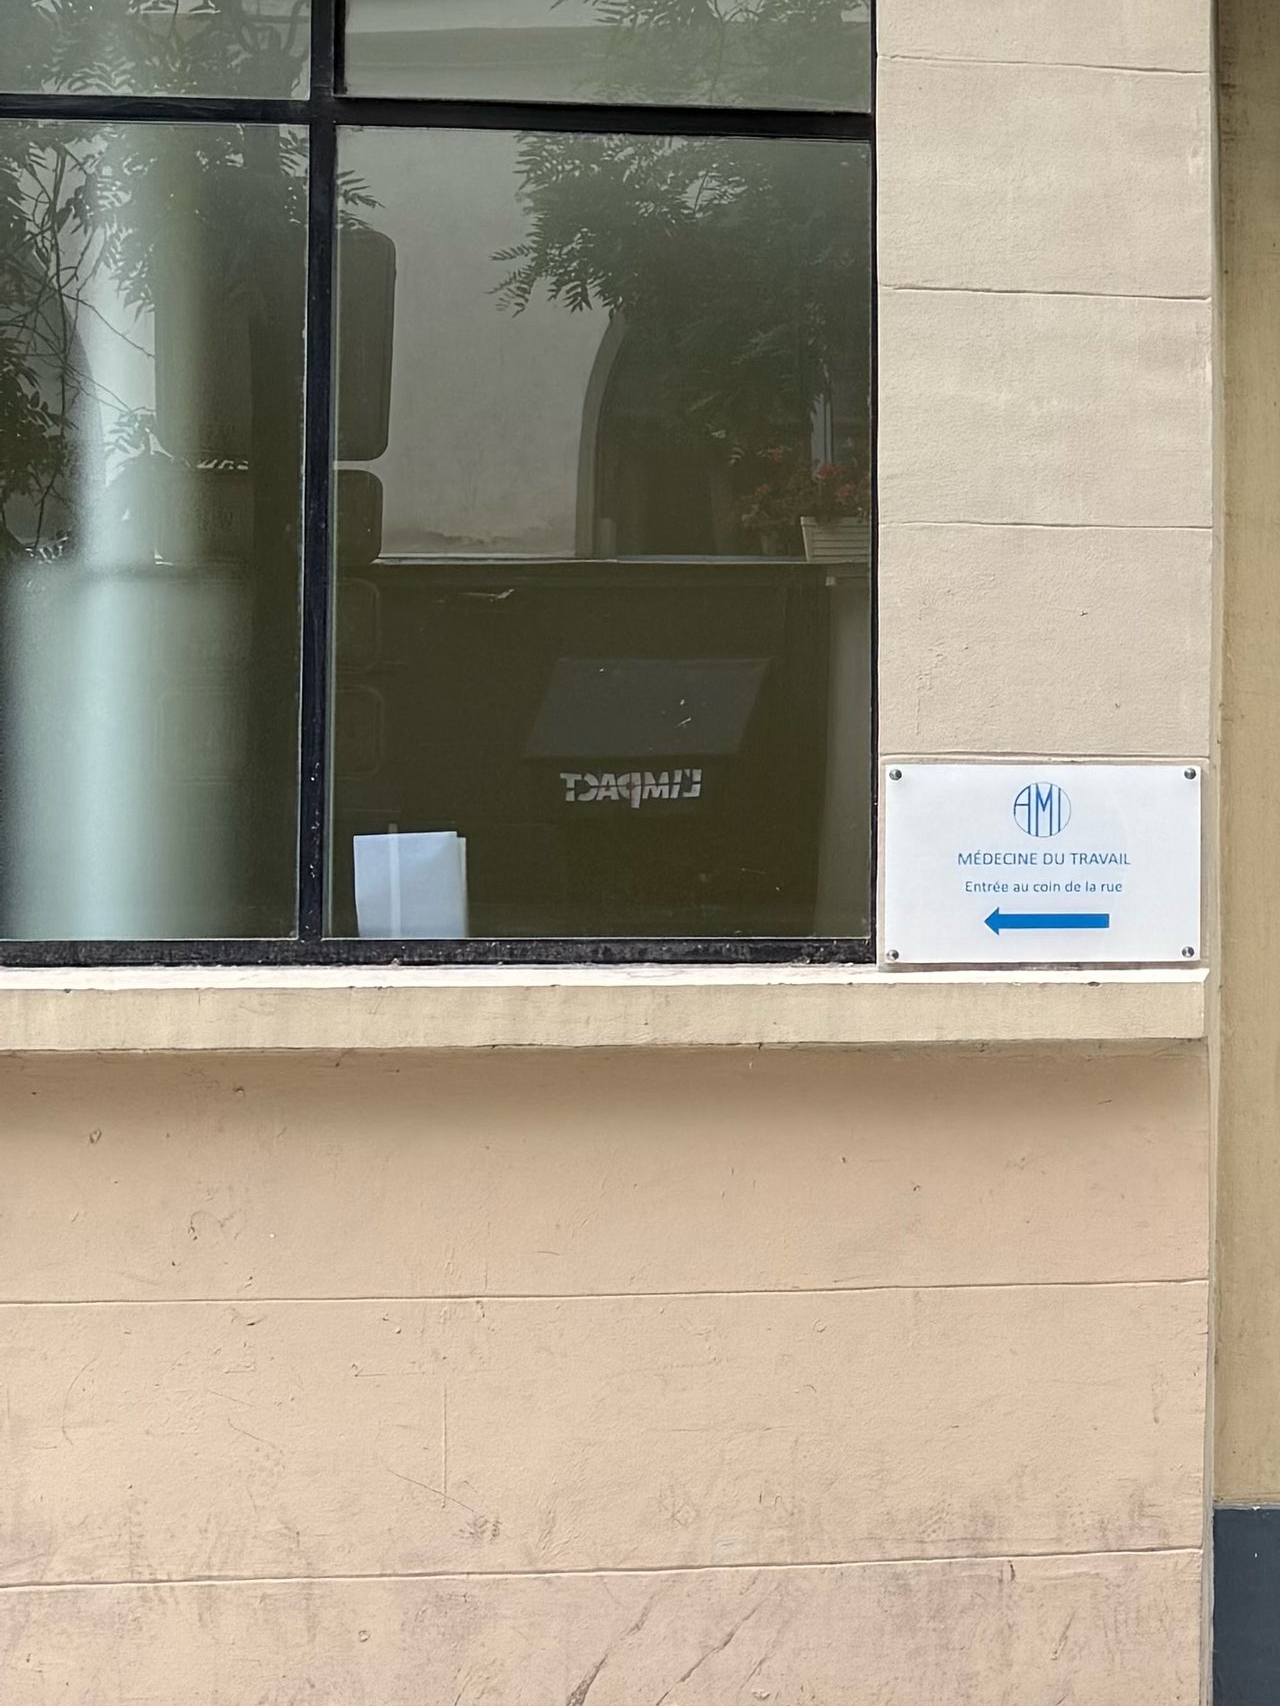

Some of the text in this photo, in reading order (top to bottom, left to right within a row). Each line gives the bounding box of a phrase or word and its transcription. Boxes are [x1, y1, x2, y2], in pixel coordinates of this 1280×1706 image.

[1013, 781, 1072, 837] AMI
[957, 849, 1131, 866] MÉDECINE DU TRAVAIL
[965, 880, 1123, 893] Entrée au coin de la rue
